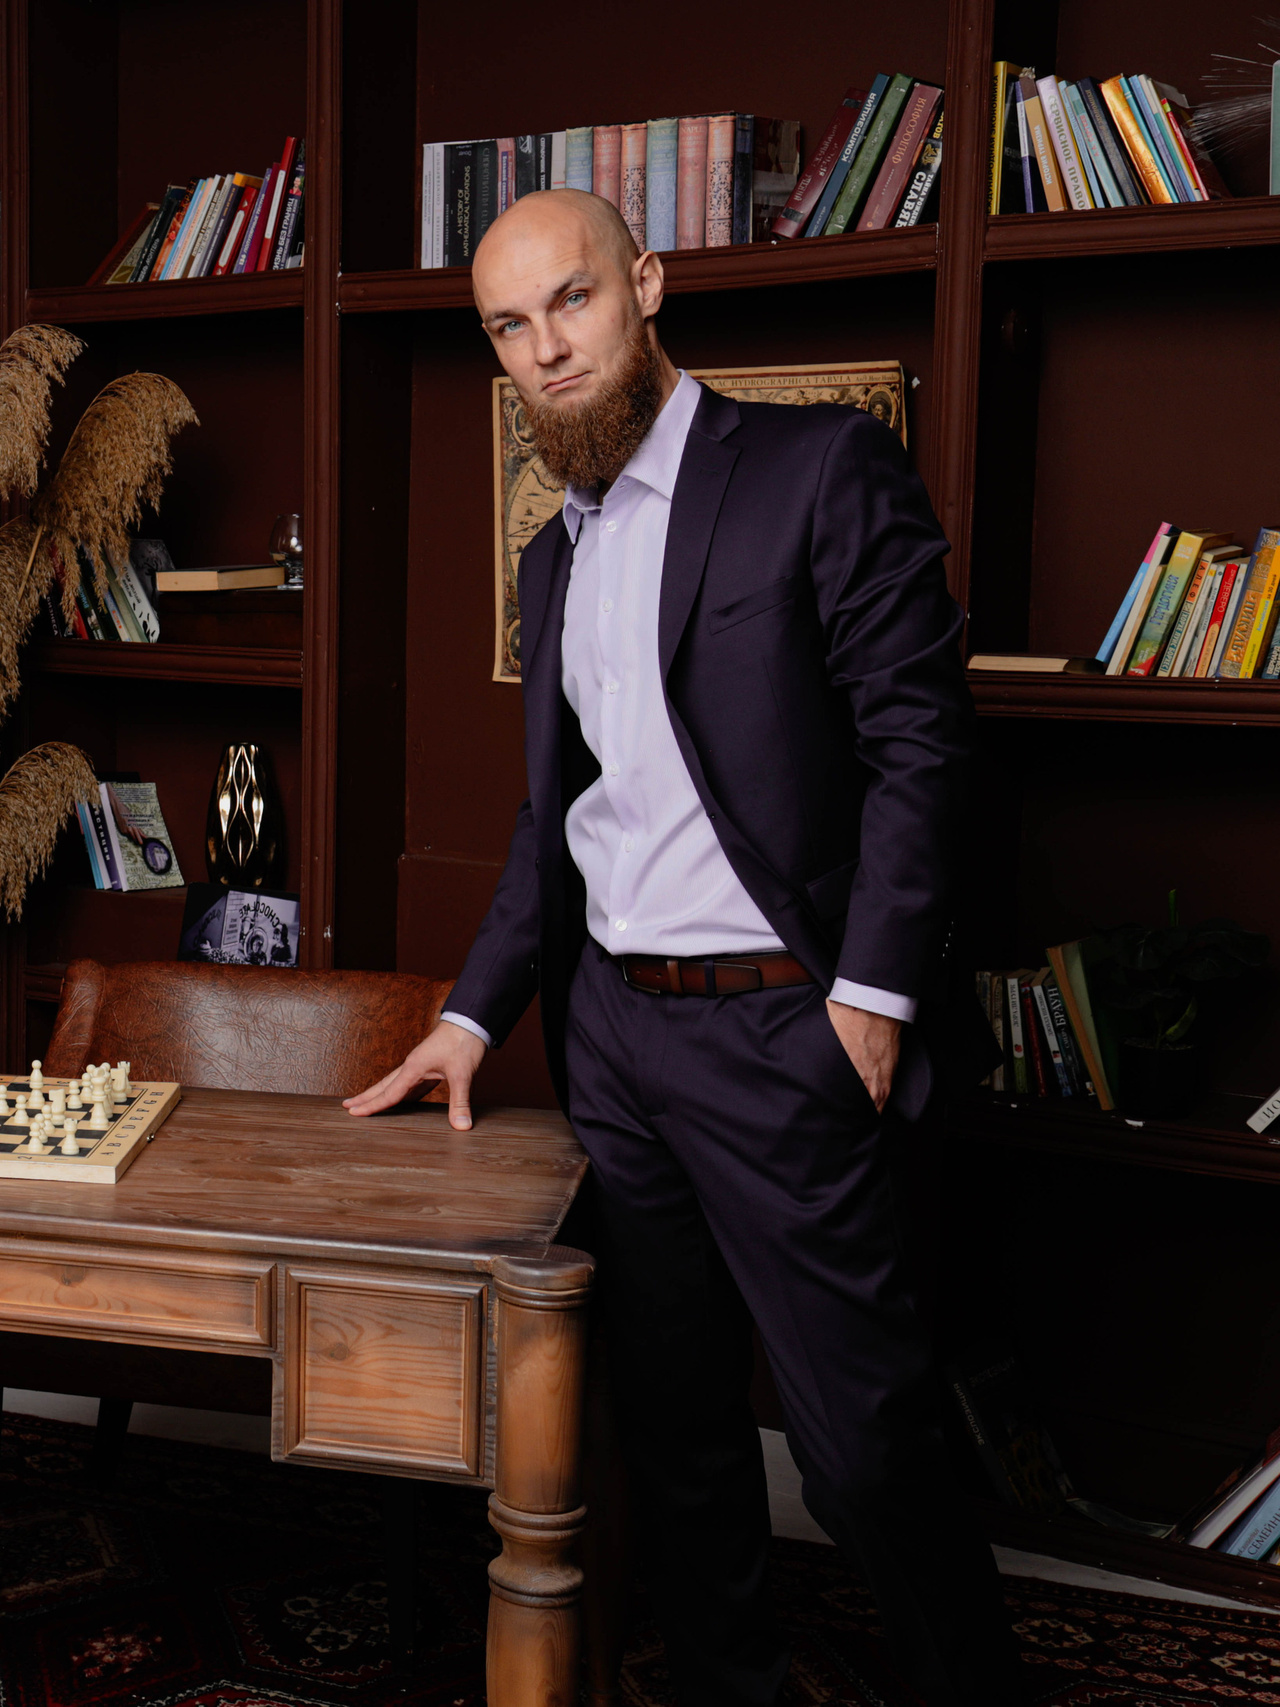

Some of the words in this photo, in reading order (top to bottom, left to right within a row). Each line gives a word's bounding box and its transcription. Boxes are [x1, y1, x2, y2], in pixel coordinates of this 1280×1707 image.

[989, 75, 998, 134] ЭКОНОМИКА
[841, 91, 877, 163] КОМПОЗИЦИЯ
[890, 96, 927, 165] ФИЛОСОФИЯ
[1032, 124, 1047, 154] ТУРИЗМА
[1045, 94, 1075, 164] СЕРВИСНОЕ
[1066, 166, 1087, 209] ПРАВО
[462, 165, 471, 203] NOTATIONS
[919, 173, 935, 197] ТАЙНА
[1039, 154, 1054, 184] ИСТОРИЯ
[457, 188, 463, 198] OF
[281, 197, 294, 229] ГРАНИЦ
[278, 229, 286, 246] БЕЗ
[461, 205, 471, 256] MATHEMATICAL
[717, 380, 729, 388] AC
[731, 377, 811, 387] HYDROGRAPHICA
[814, 376, 851, 384] TABVLA
[1188, 564, 1206, 598] АЛЕФ
[1214, 581, 1233, 613] ДЕВЕРО
[46, 595, 58, 635] БИЗНЕСА
[1176, 613, 1188, 631] ХОРХЕ
[1229, 599, 1256, 652] ПИКУЛЬ
[1170, 631, 1181, 647] ЛУИС
[1161, 646, 1175, 669] БОРХЕС
[1045, 986, 1068, 1027] БРАУН
[952, 1381, 985, 1446] ЭКСПОЗИЦИЯ
